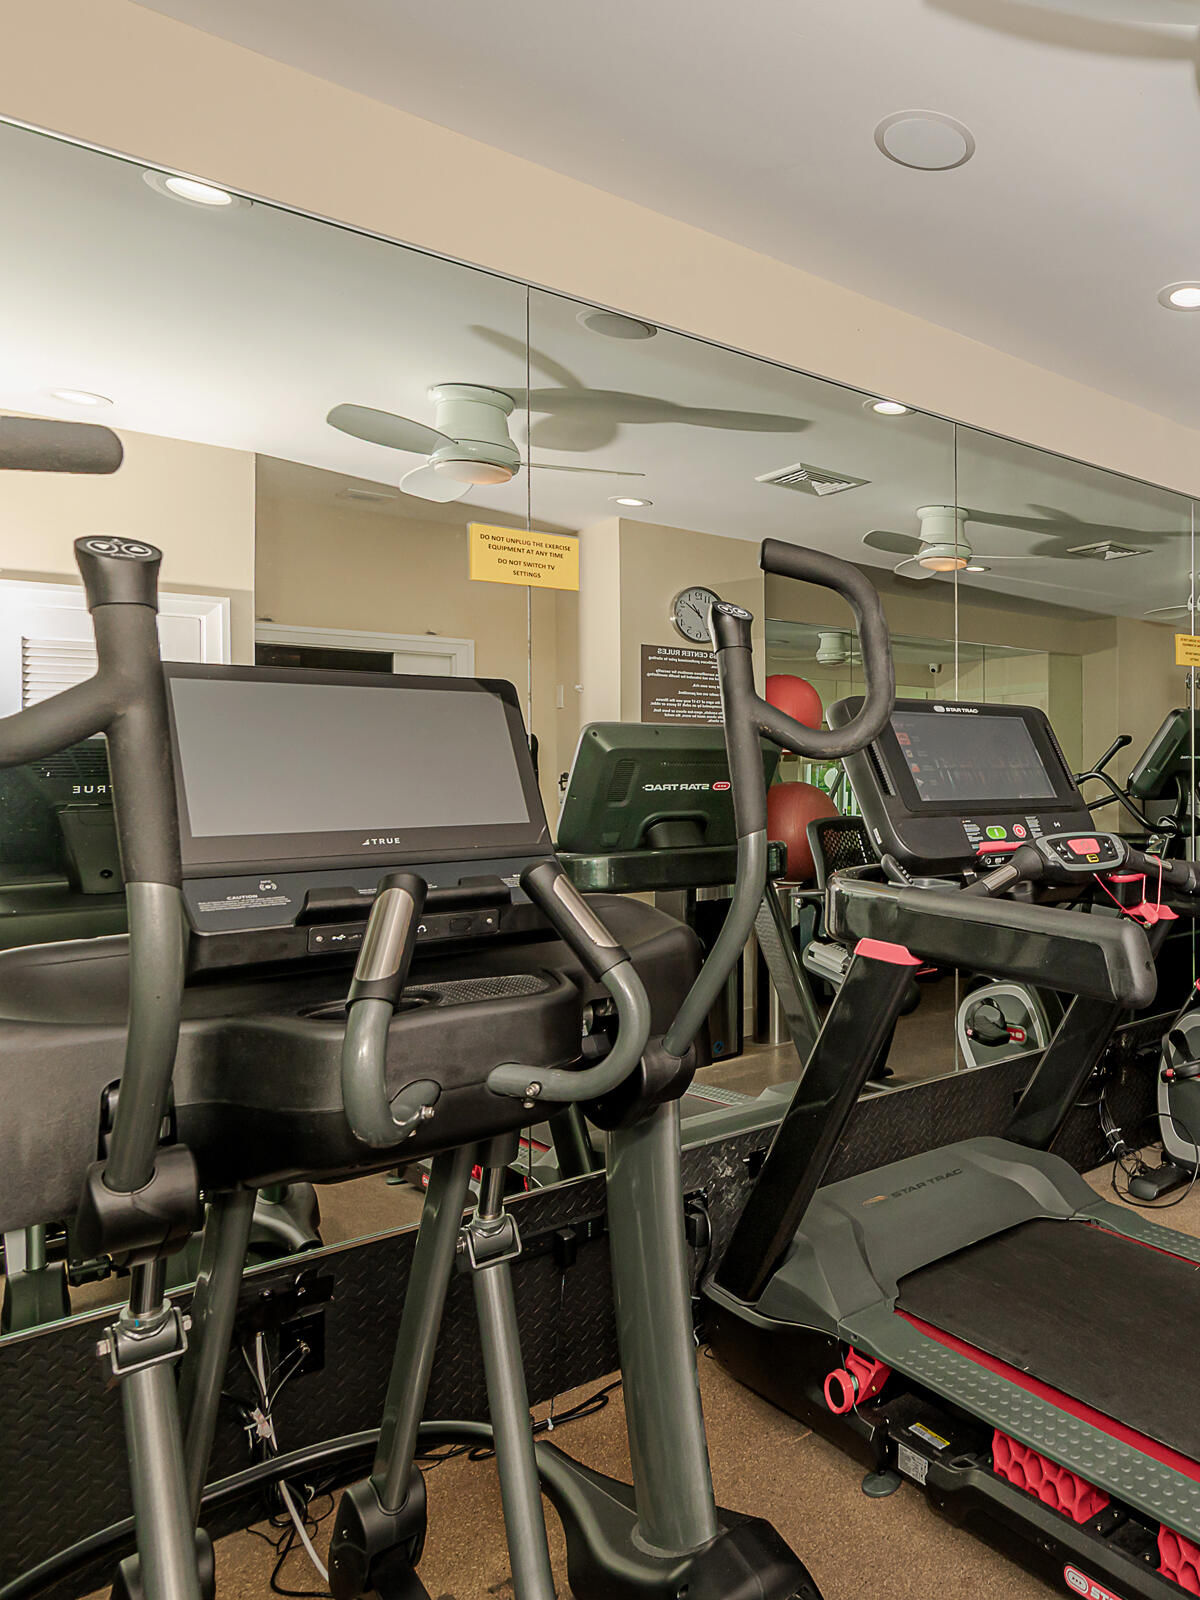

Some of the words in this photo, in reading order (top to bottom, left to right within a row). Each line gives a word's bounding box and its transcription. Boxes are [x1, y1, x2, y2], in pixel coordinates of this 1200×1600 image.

[488, 543, 525, 554] EQUIPMENT
[535, 549, 548, 557] ANY
[505, 537, 532, 546] UNPLUG
[544, 543, 571, 552] EXERCISE
[523, 561, 546, 569] SWITCH
[512, 570, 541, 579] SETTINGS
[371, 837, 400, 845] TRUE
[890, 1182, 927, 1198] STAR
[926, 1168, 963, 1185] TRAC
